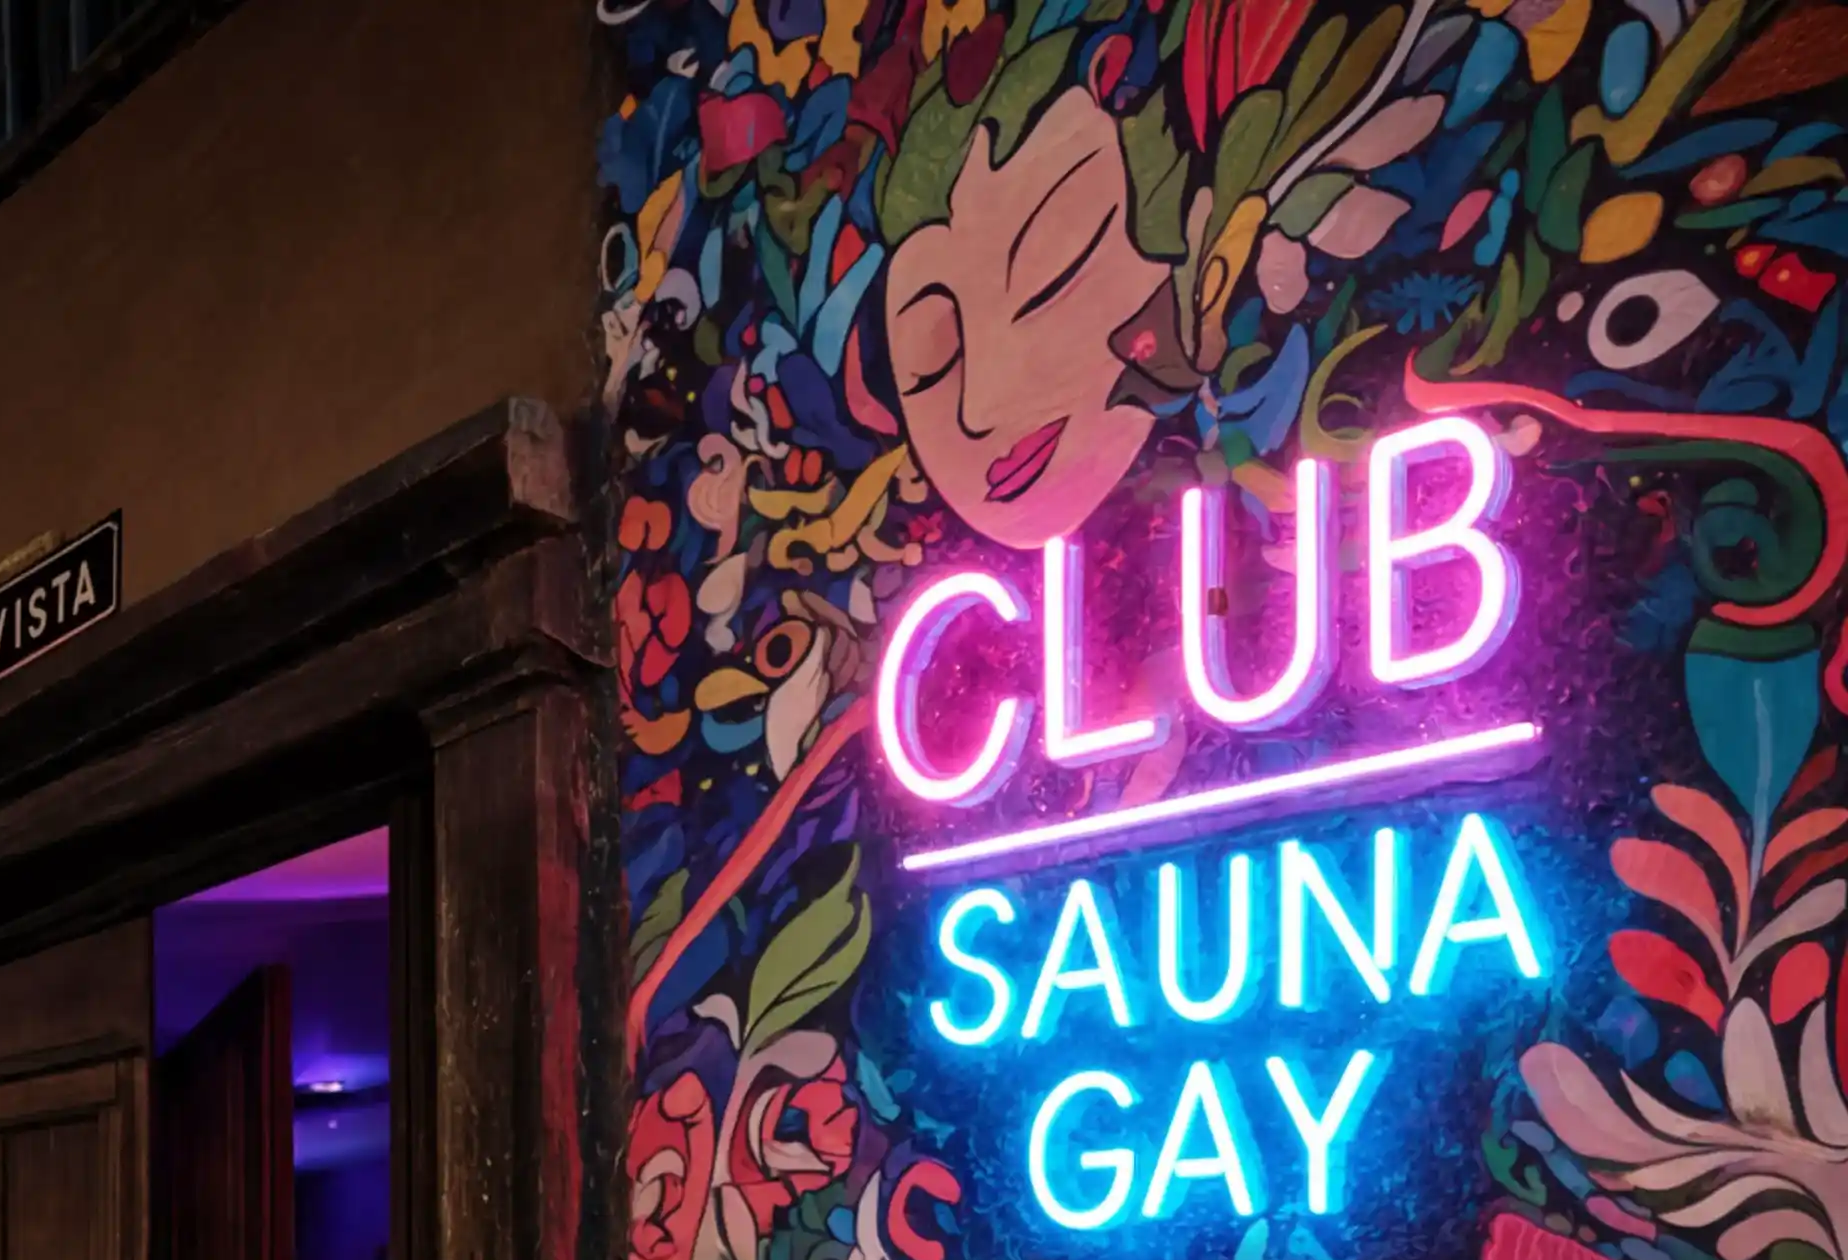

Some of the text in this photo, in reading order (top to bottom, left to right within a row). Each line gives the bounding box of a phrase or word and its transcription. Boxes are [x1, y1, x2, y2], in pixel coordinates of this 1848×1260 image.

[877, 416, 1516, 803] CLUB
[930, 813, 1543, 1046] SAUNA
[1028, 1049, 1375, 1229] GAY
